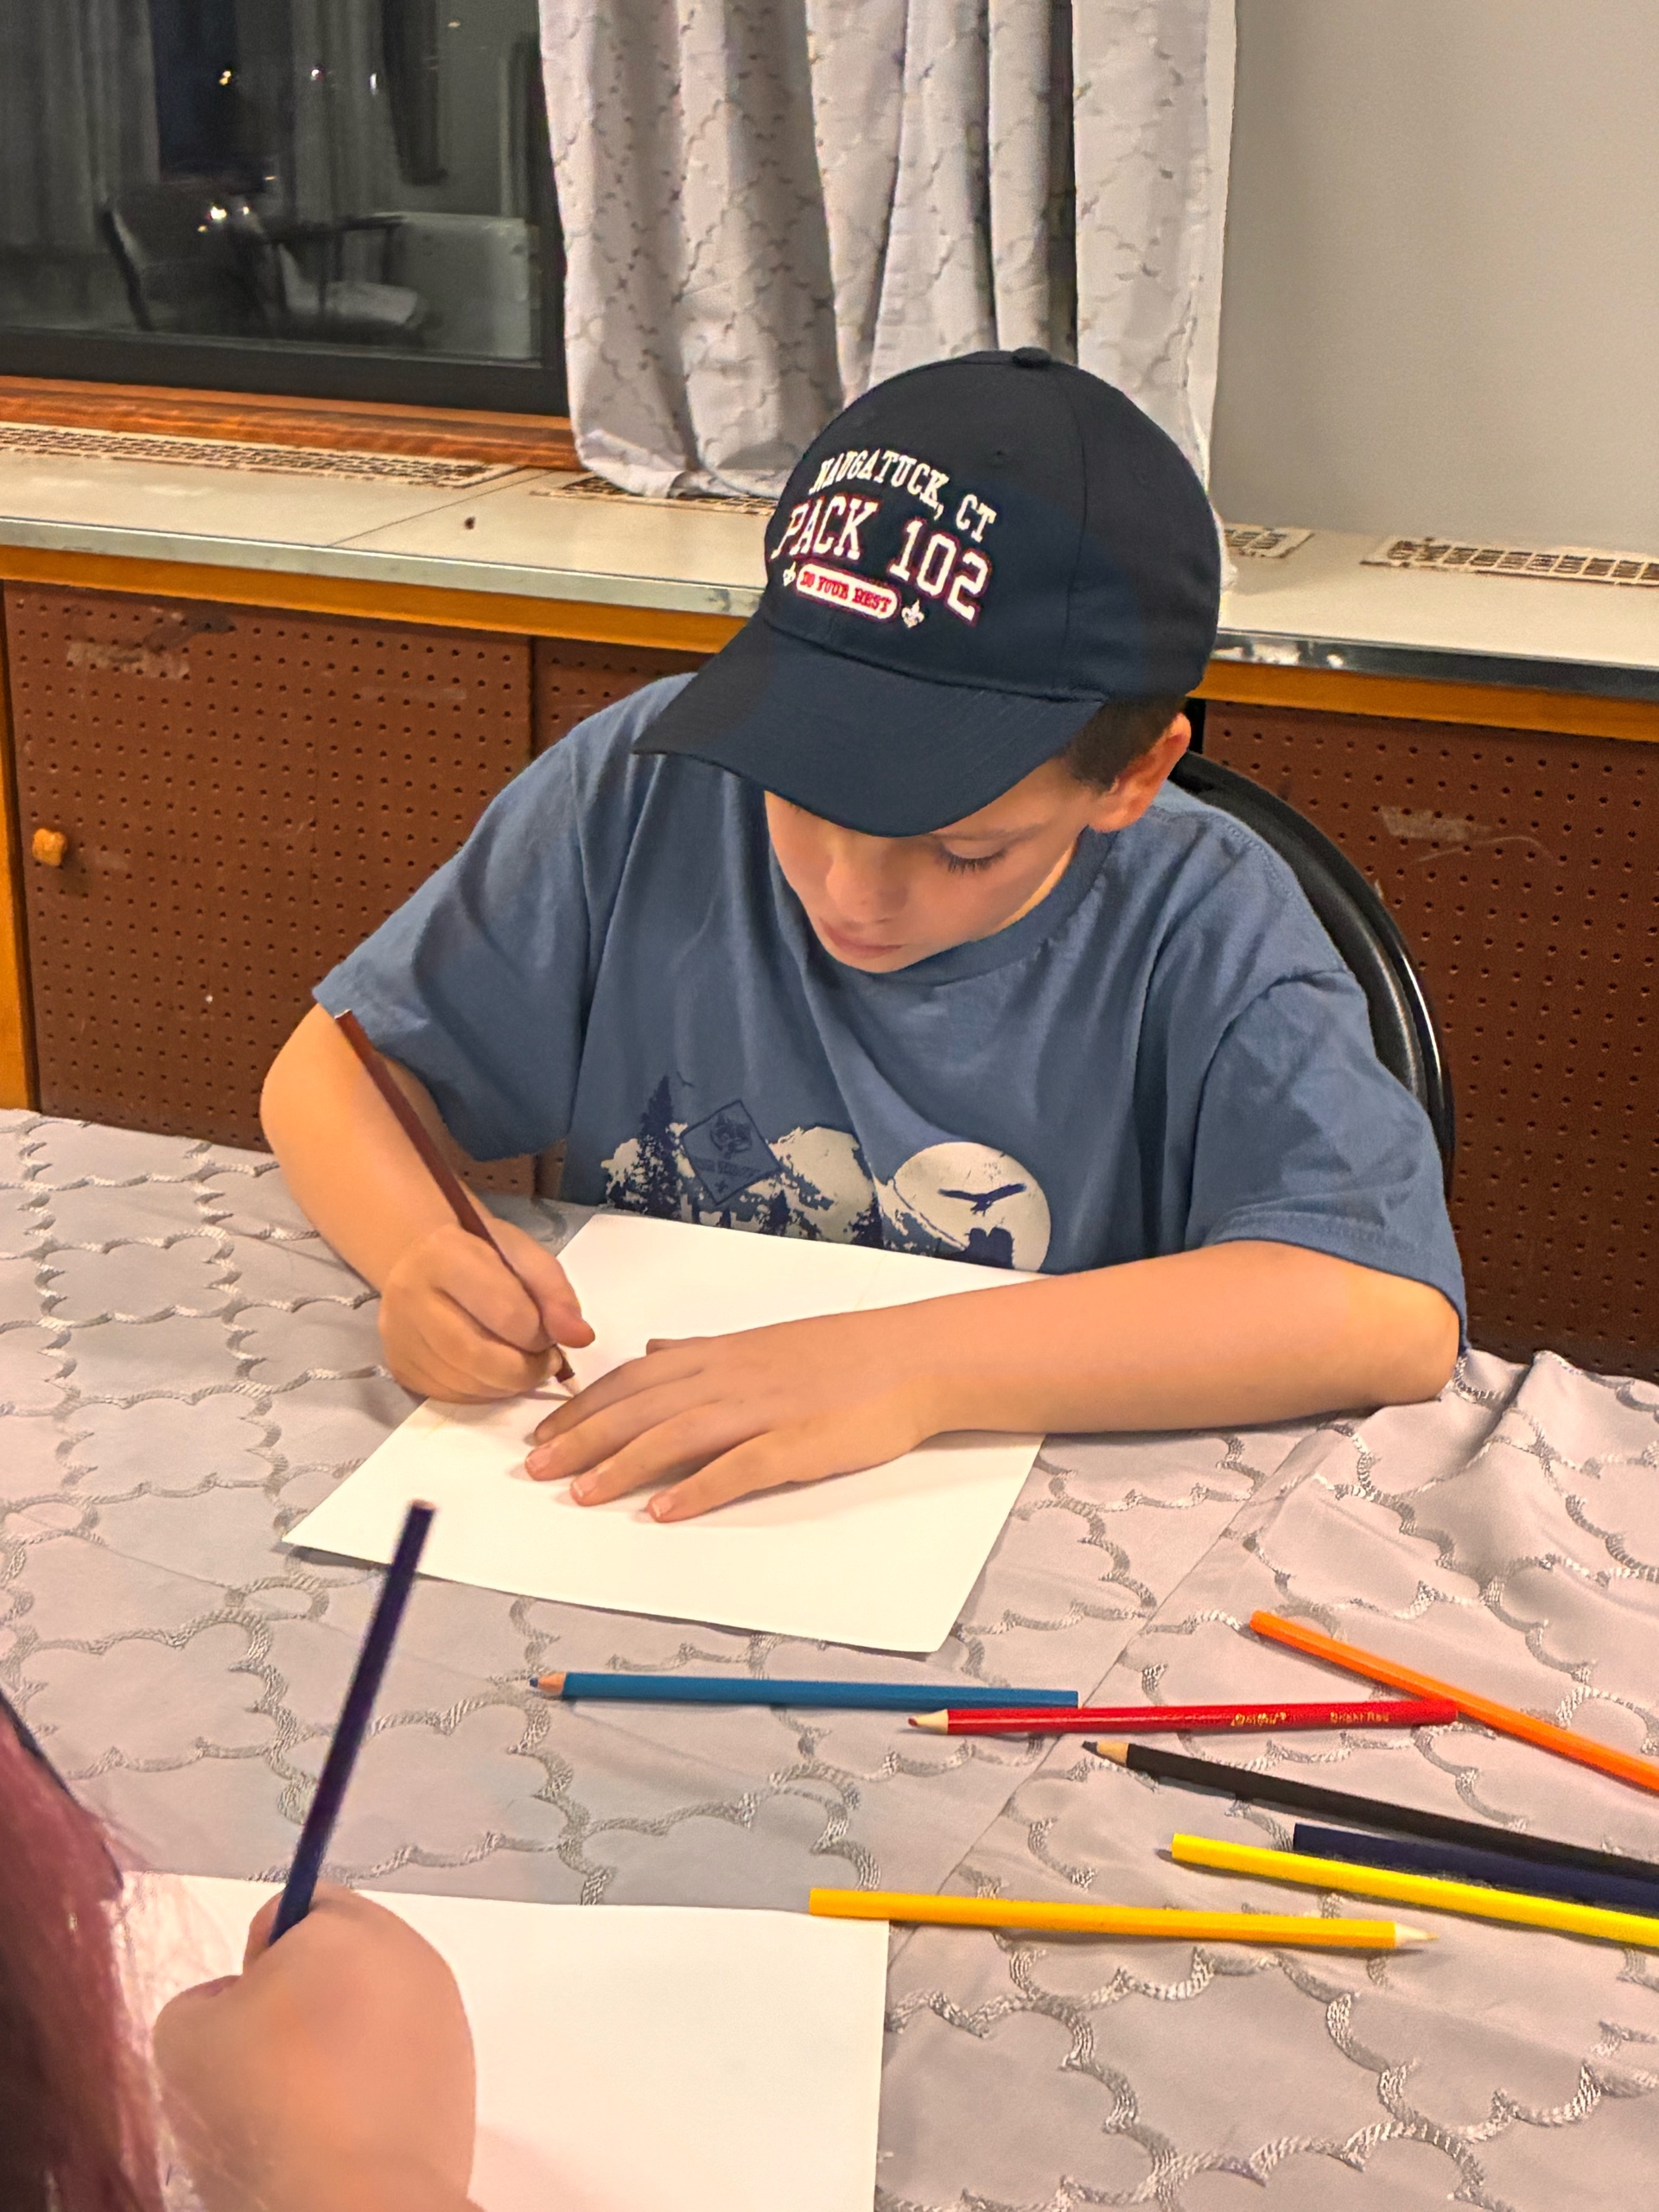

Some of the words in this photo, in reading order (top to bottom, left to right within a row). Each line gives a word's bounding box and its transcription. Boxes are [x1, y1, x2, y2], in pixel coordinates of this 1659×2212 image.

[809, 448, 949, 520] NAUGATUCK,
[956, 494, 997, 543] CT
[770, 494, 880, 560] PACK
[888, 518, 991, 625] 102
[817, 575, 849, 600] YOUR
[852, 588, 892, 613] BEST
